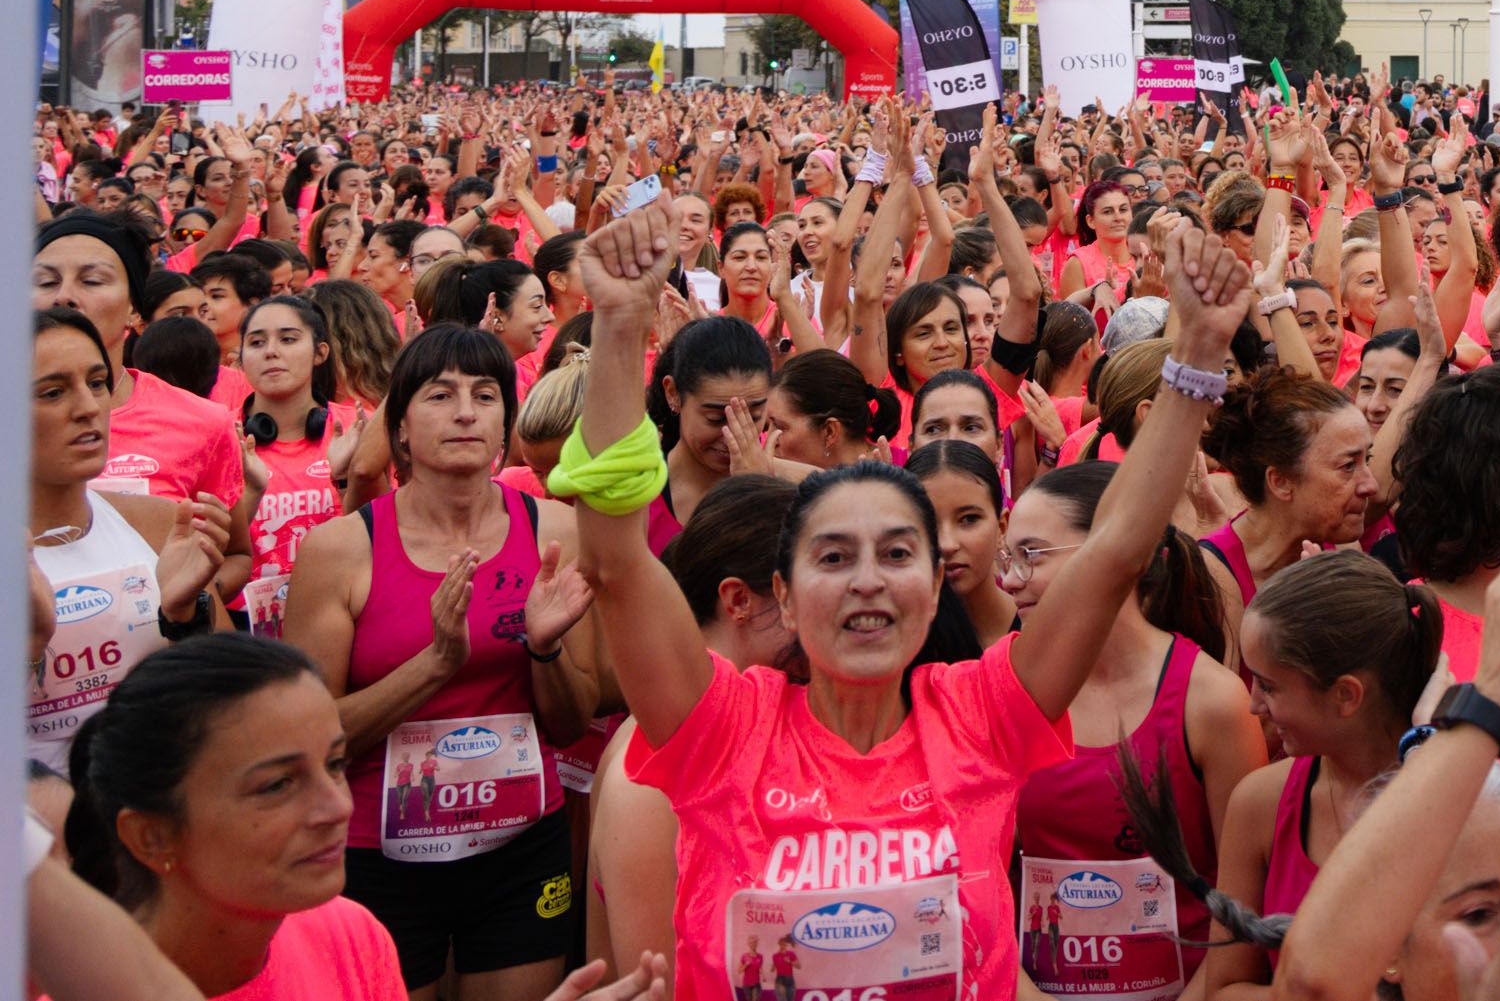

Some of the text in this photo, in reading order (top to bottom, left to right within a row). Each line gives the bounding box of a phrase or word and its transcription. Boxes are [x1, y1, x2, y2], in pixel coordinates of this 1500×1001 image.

[194, 56, 229, 65] OYSHO
[219, 47, 298, 70] YSHO
[1060, 53, 1127, 73] OYSHO
[145, 73, 230, 87] CORREDORAS
[54, 640, 122, 679] 016
[75, 674, 109, 693] 3382
[57, 700, 70, 710] DE
[71, 696, 84, 706] LA
[401, 735, 432, 746] SUMA
[441, 739, 497, 753] ASTURIANA
[438, 780, 497, 809] 016
[398, 826, 434, 838] CARRERA
[436, 825, 447, 834] DE
[448, 824, 459, 833] LA
[460, 821, 485, 832] MUJER
[491, 820, 498, 828] A
[498, 815, 528, 827] CORUÑA
[400, 842, 452, 856] OYSHO
[765, 825, 960, 891] CARRERA
[1062, 884, 1118, 900] ASTURIANA
[746, 910, 785, 924] SUMA
[801, 922, 889, 941] ASTURIANA
[1063, 936, 1123, 963] 016
[1065, 983, 1075, 993] DE
[1077, 983, 1087, 992] LA
[1089, 983, 1116, 992] MUJER
[1123, 981, 1130, 990] A
[1131, 977, 1167, 990] CORUÑA
